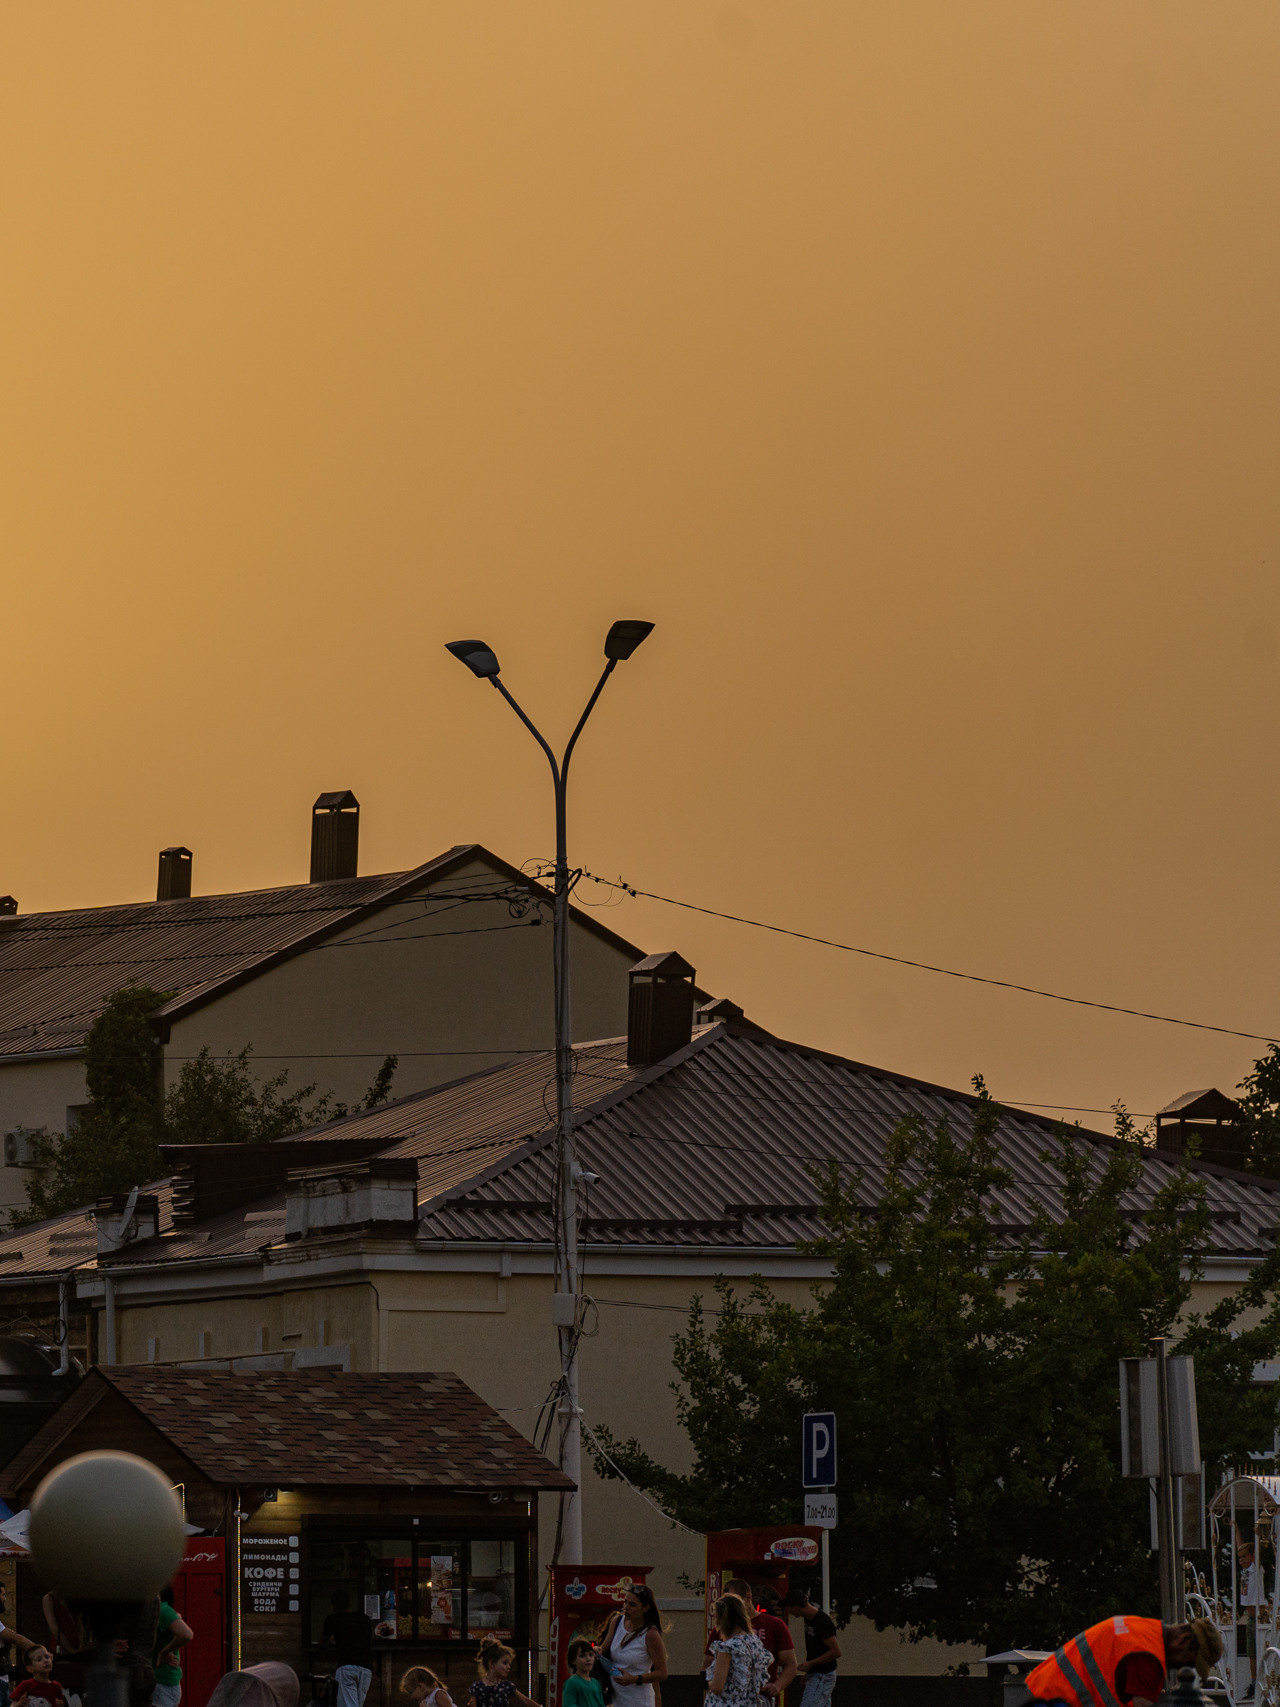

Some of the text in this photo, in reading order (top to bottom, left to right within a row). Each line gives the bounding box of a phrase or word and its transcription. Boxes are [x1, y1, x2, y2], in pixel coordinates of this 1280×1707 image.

[812, 1422, 830, 1479] P
[806, 1504, 836, 1520] 7.00-21.00
[242, 1537, 288, 1545] МОРОЖЕНОЕ
[244, 1567, 285, 1579] КОФЕ
